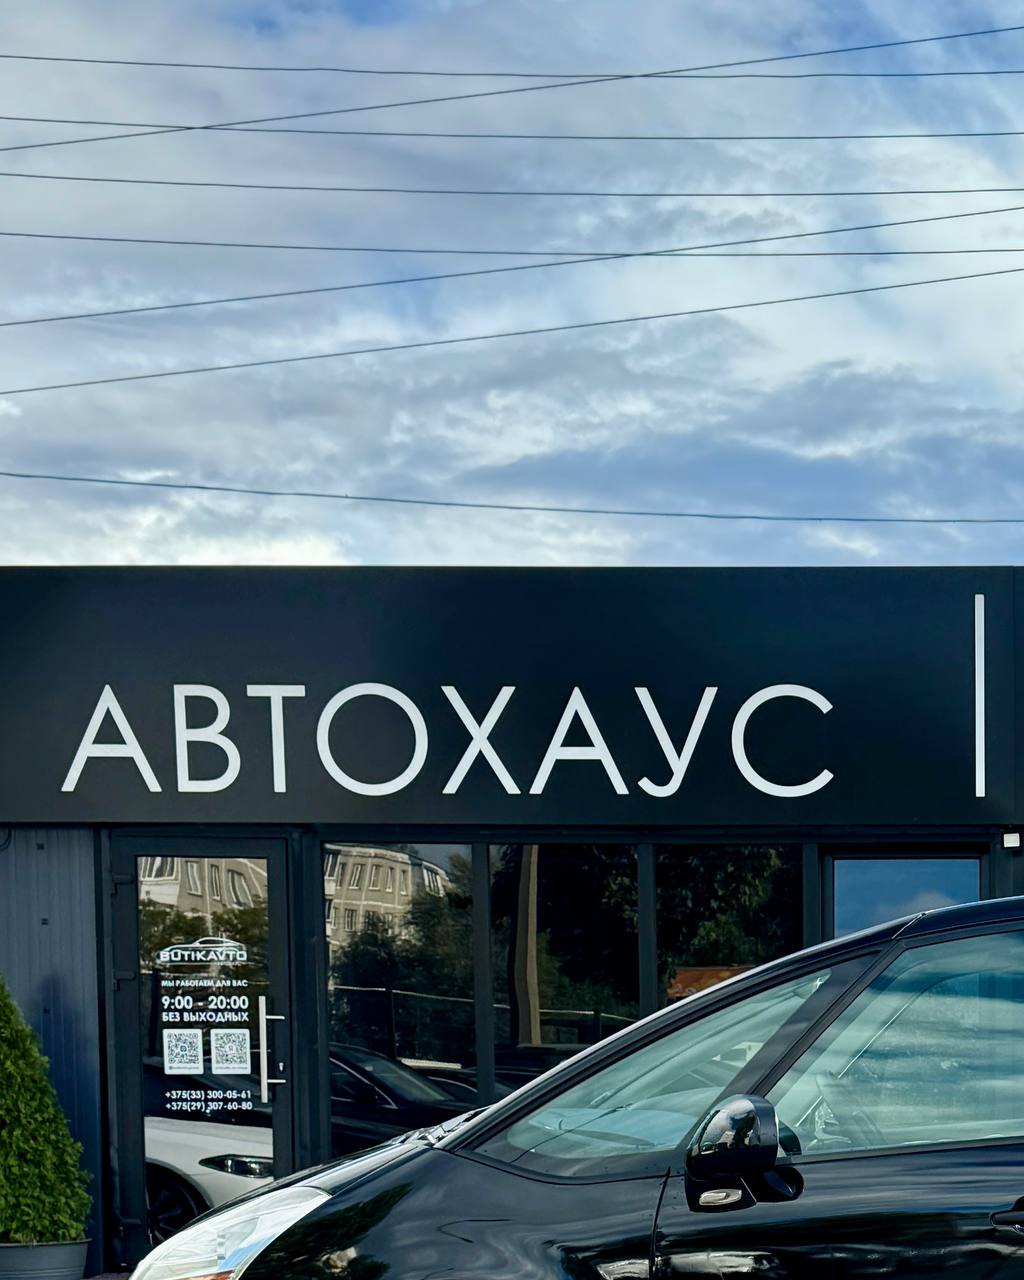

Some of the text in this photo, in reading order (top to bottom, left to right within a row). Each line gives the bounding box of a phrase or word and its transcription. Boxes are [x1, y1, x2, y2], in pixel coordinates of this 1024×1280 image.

[61, 682, 834, 798] АВТОХАУС
[160, 950, 247, 961] BUTIKAVTO
[161, 996, 193, 1009] 9:00
[208, 996, 249, 1009] 20:00
[162, 1012, 249, 1022] БЕЗ ВЫХОДНЫХ
[165, 1090, 251, 1100] +375(33) 300-05-61
[166, 1102, 253, 1112] +375(29) 307-60-80
